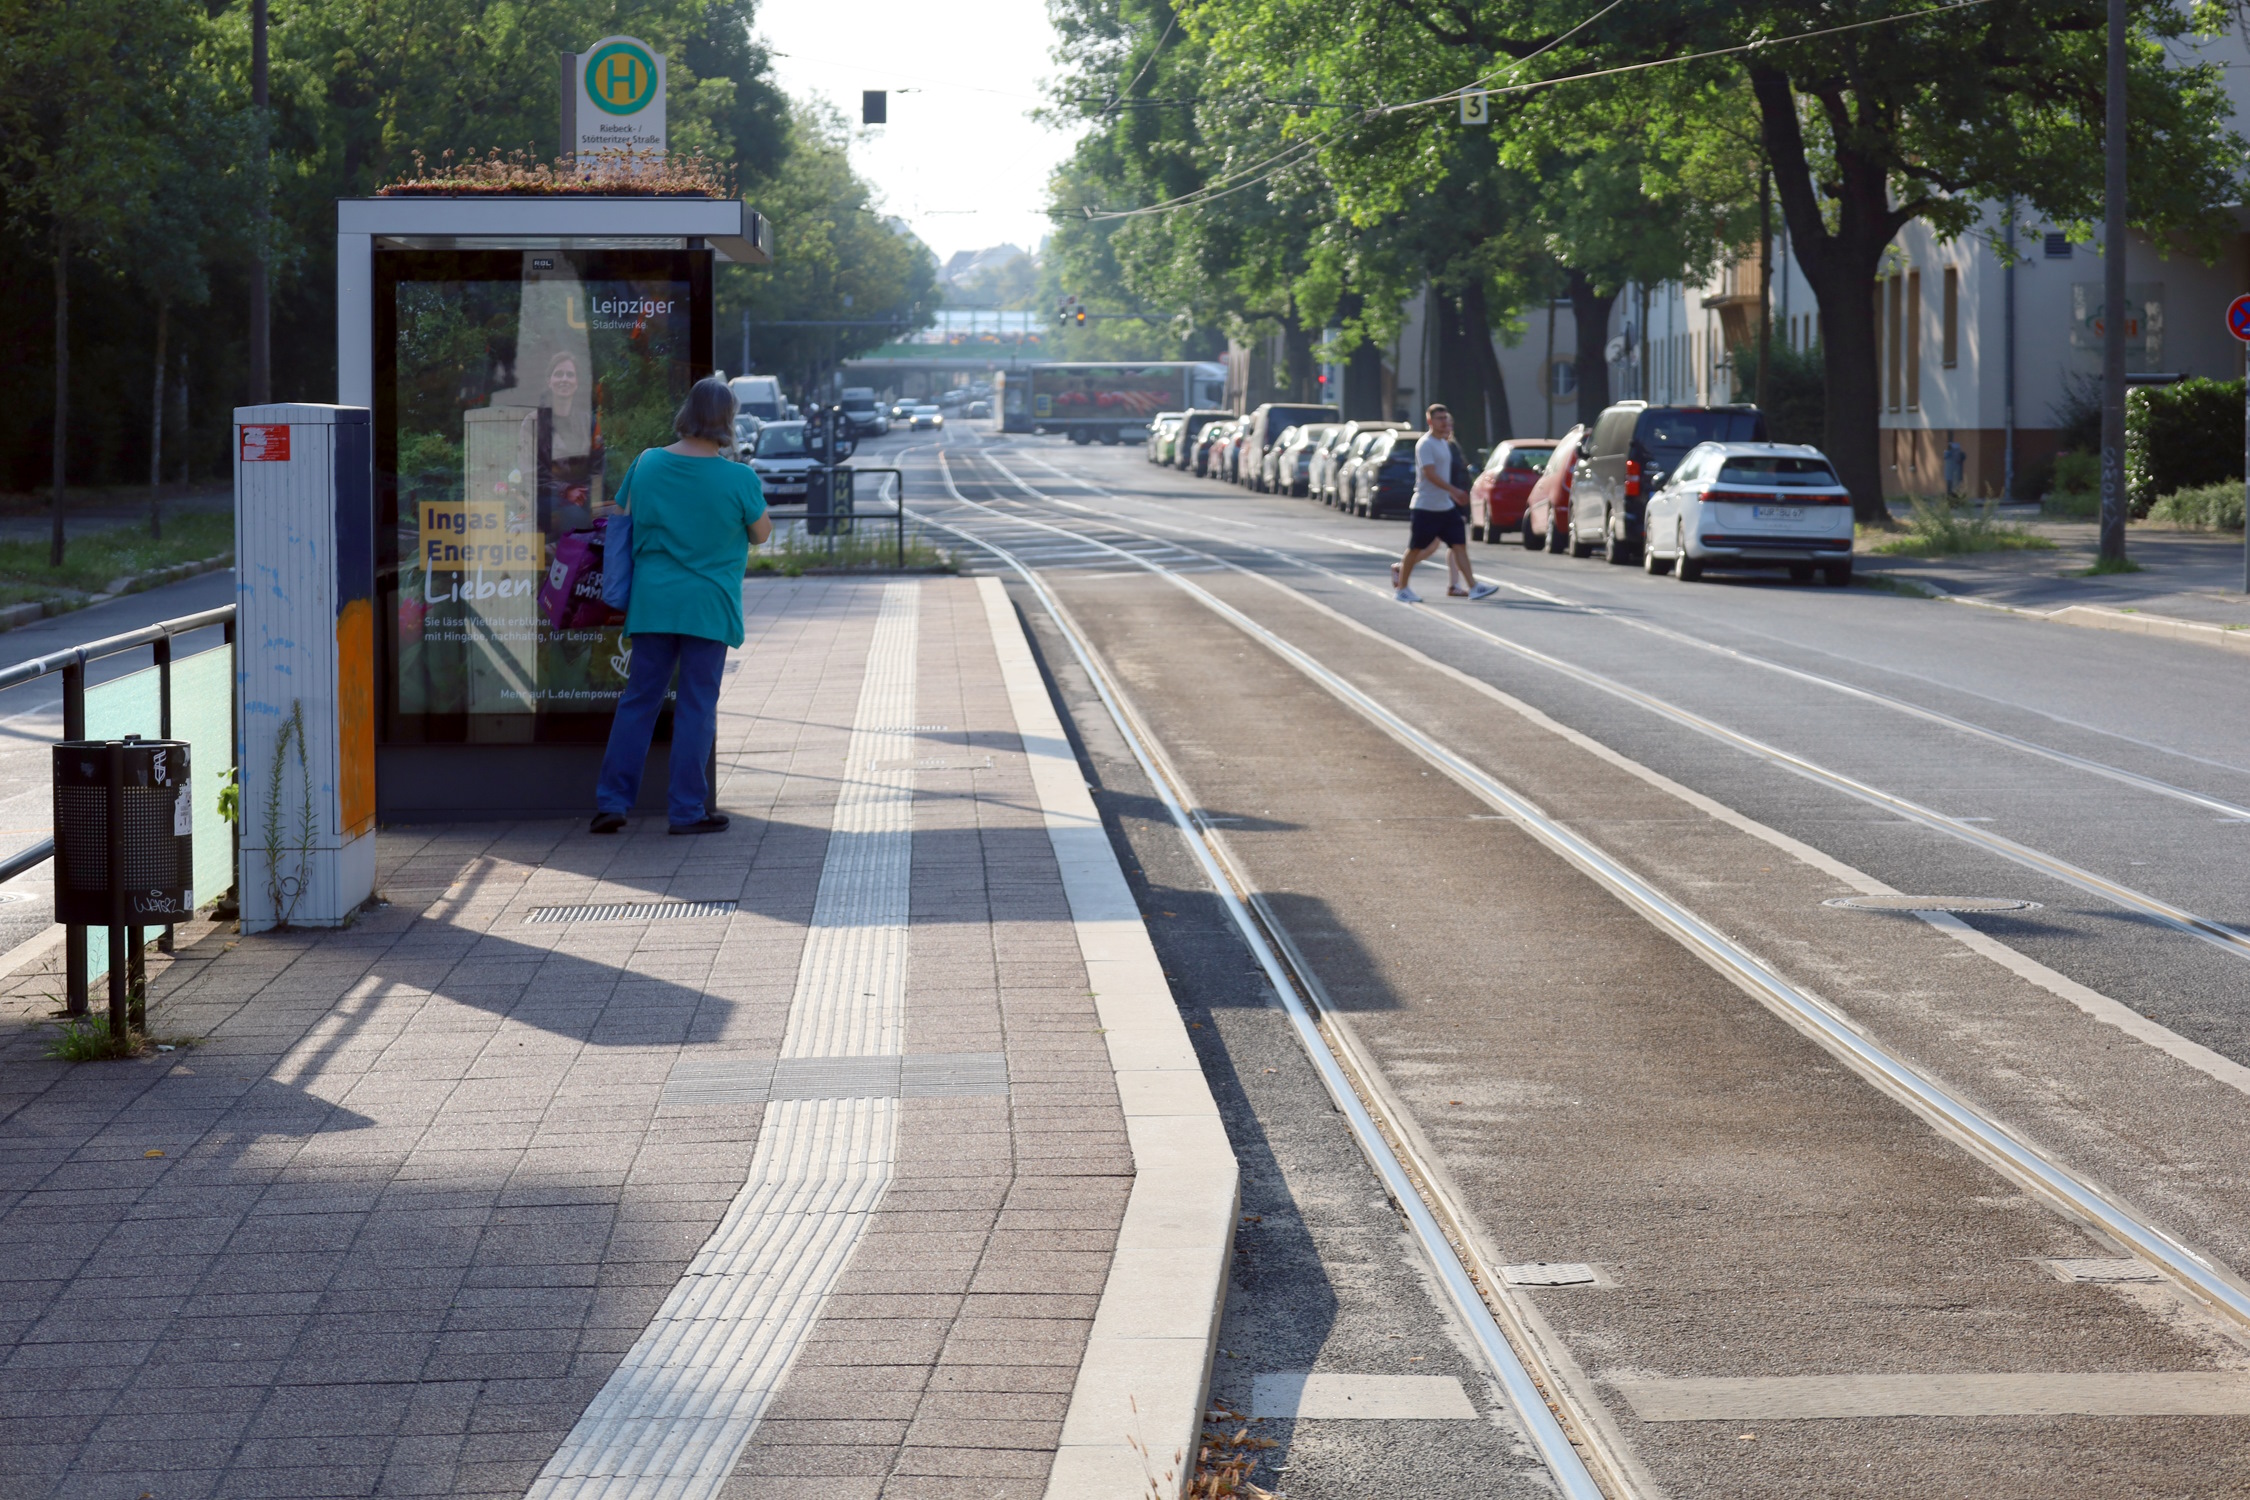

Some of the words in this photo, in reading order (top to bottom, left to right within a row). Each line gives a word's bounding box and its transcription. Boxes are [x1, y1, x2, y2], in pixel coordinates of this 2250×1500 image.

[606, 59, 636, 99] H
[1468, 93, 1482, 118] 3
[600, 124, 636, 133] Riebeck-
[582, 135, 630, 145] Stötteritzer
[633, 135, 660, 144] Straße
[592, 296, 675, 318] Leipziger
[592, 319, 647, 330] Stadtwerke
[427, 508, 498, 534] Ingas
[427, 540, 537, 566] Energie.
[424, 557, 533, 604] Lieben
[425, 616, 440, 626] Sie
[443, 616, 467, 626] lässt
[470, 616, 505, 626] Vielfalt
[425, 632, 441, 641] mit
[444, 632, 488, 643] Hingabe,
[491, 632, 547, 643] nachhaltig,
[550, 632, 564, 641] für
[567, 632, 606, 642] Leipzig.
[500, 689, 526, 699] Mehr
[530, 689, 545, 699] auf
